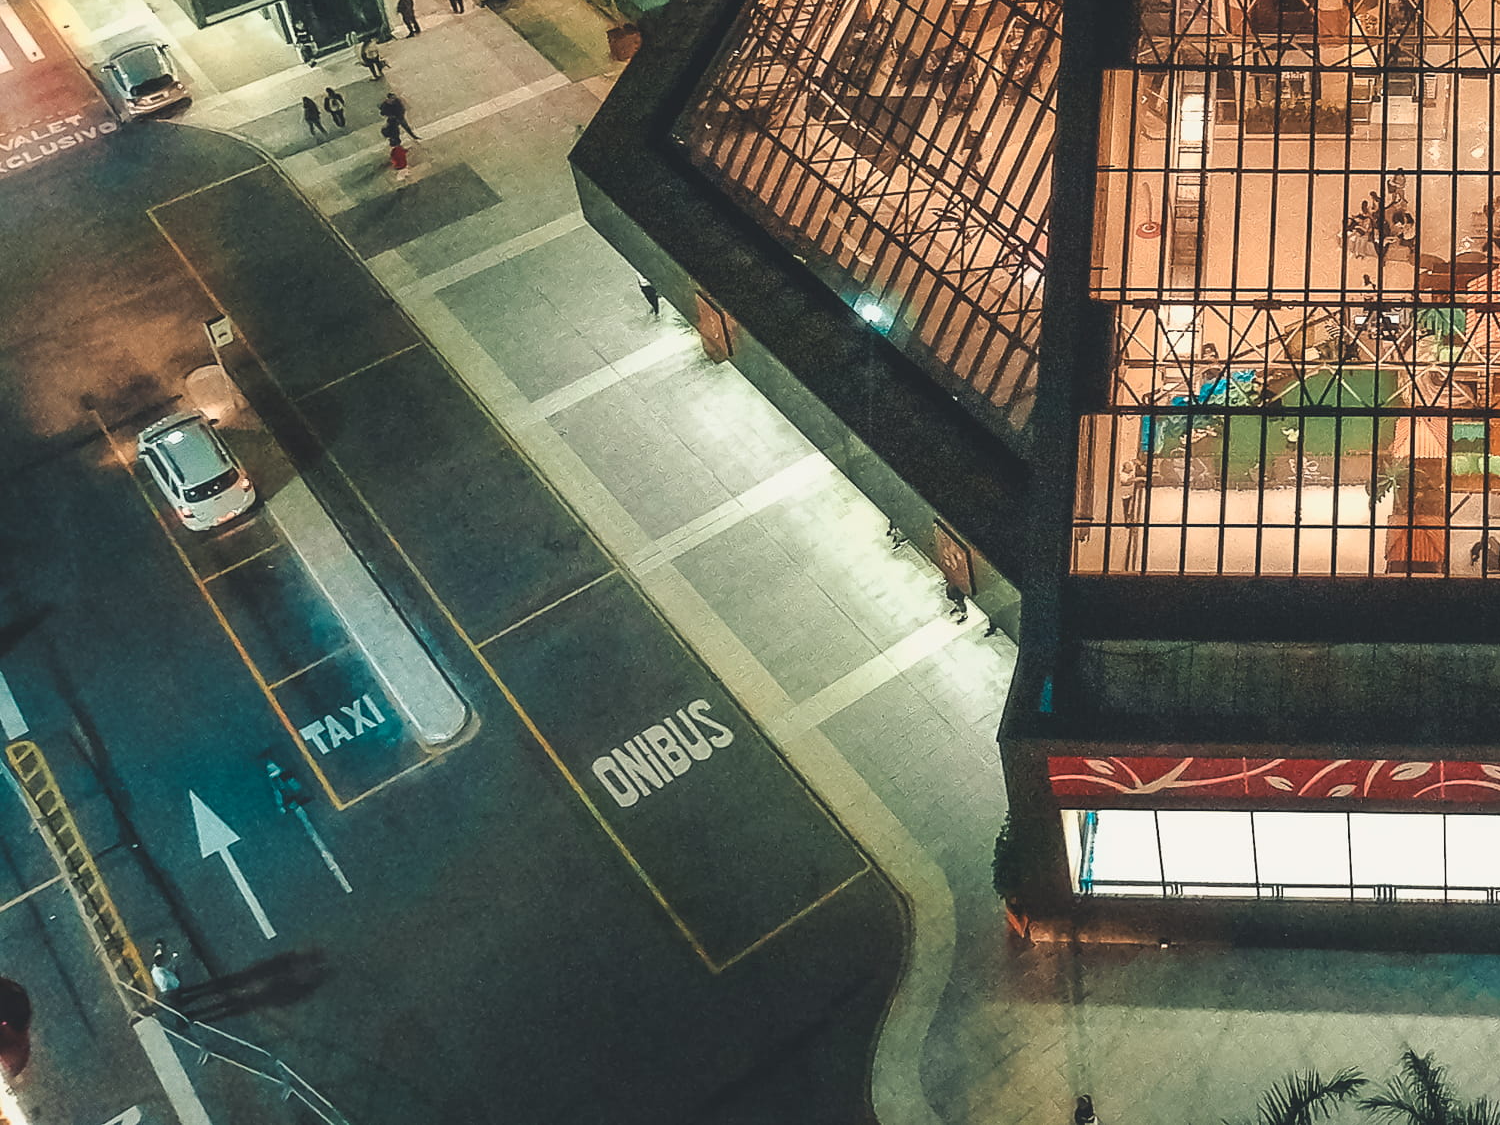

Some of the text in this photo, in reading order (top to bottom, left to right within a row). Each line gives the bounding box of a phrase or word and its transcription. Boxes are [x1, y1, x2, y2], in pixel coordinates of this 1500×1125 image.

[0, 114, 83, 151] VALET
[298, 693, 386, 755] TAXI
[591, 698, 734, 808] ONIBUS
